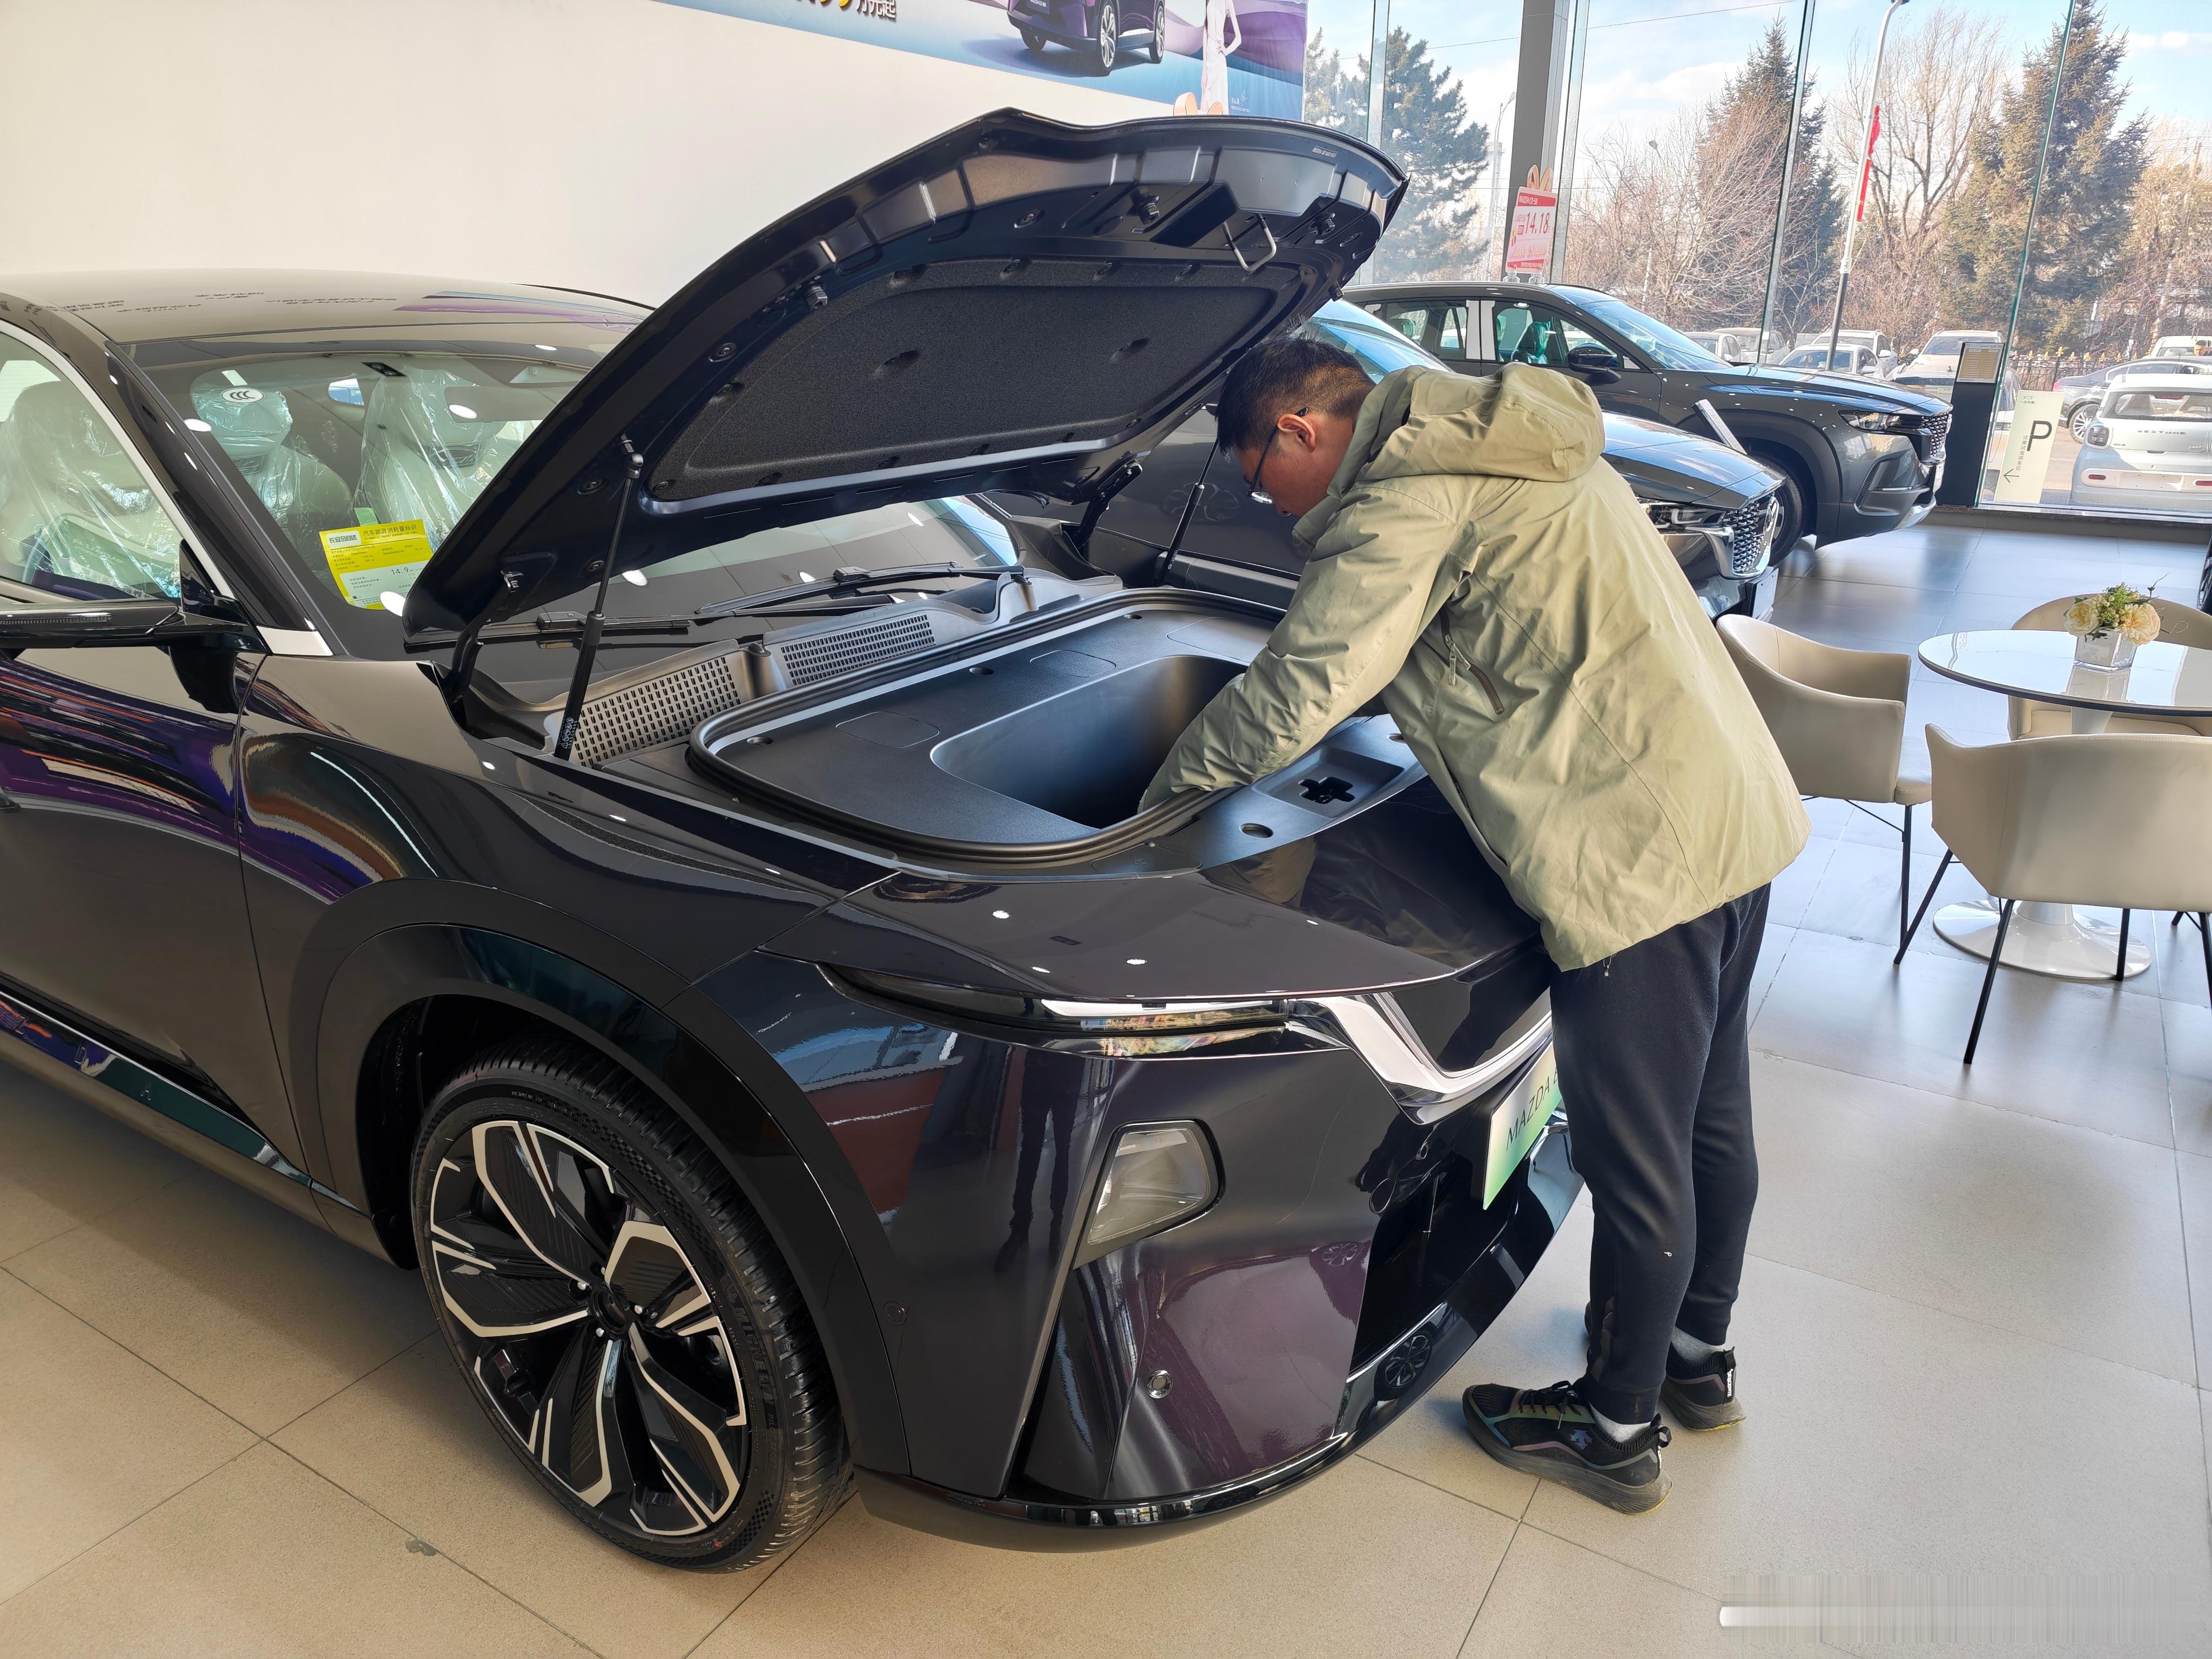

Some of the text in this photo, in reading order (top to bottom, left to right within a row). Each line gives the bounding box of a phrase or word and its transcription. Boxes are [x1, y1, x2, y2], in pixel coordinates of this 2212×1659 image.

[1526, 213, 1550, 234] 14.18
[2026, 420, 2052, 451] P
[329, 535, 358, 543] 长安马自达
[363, 524, 417, 536] 汽车能源消耗量标识
[392, 567, 409, 575] 14.9
[1506, 1076, 1550, 1151] MAZDA
[734, 1307, 774, 1404] MICHELIN
